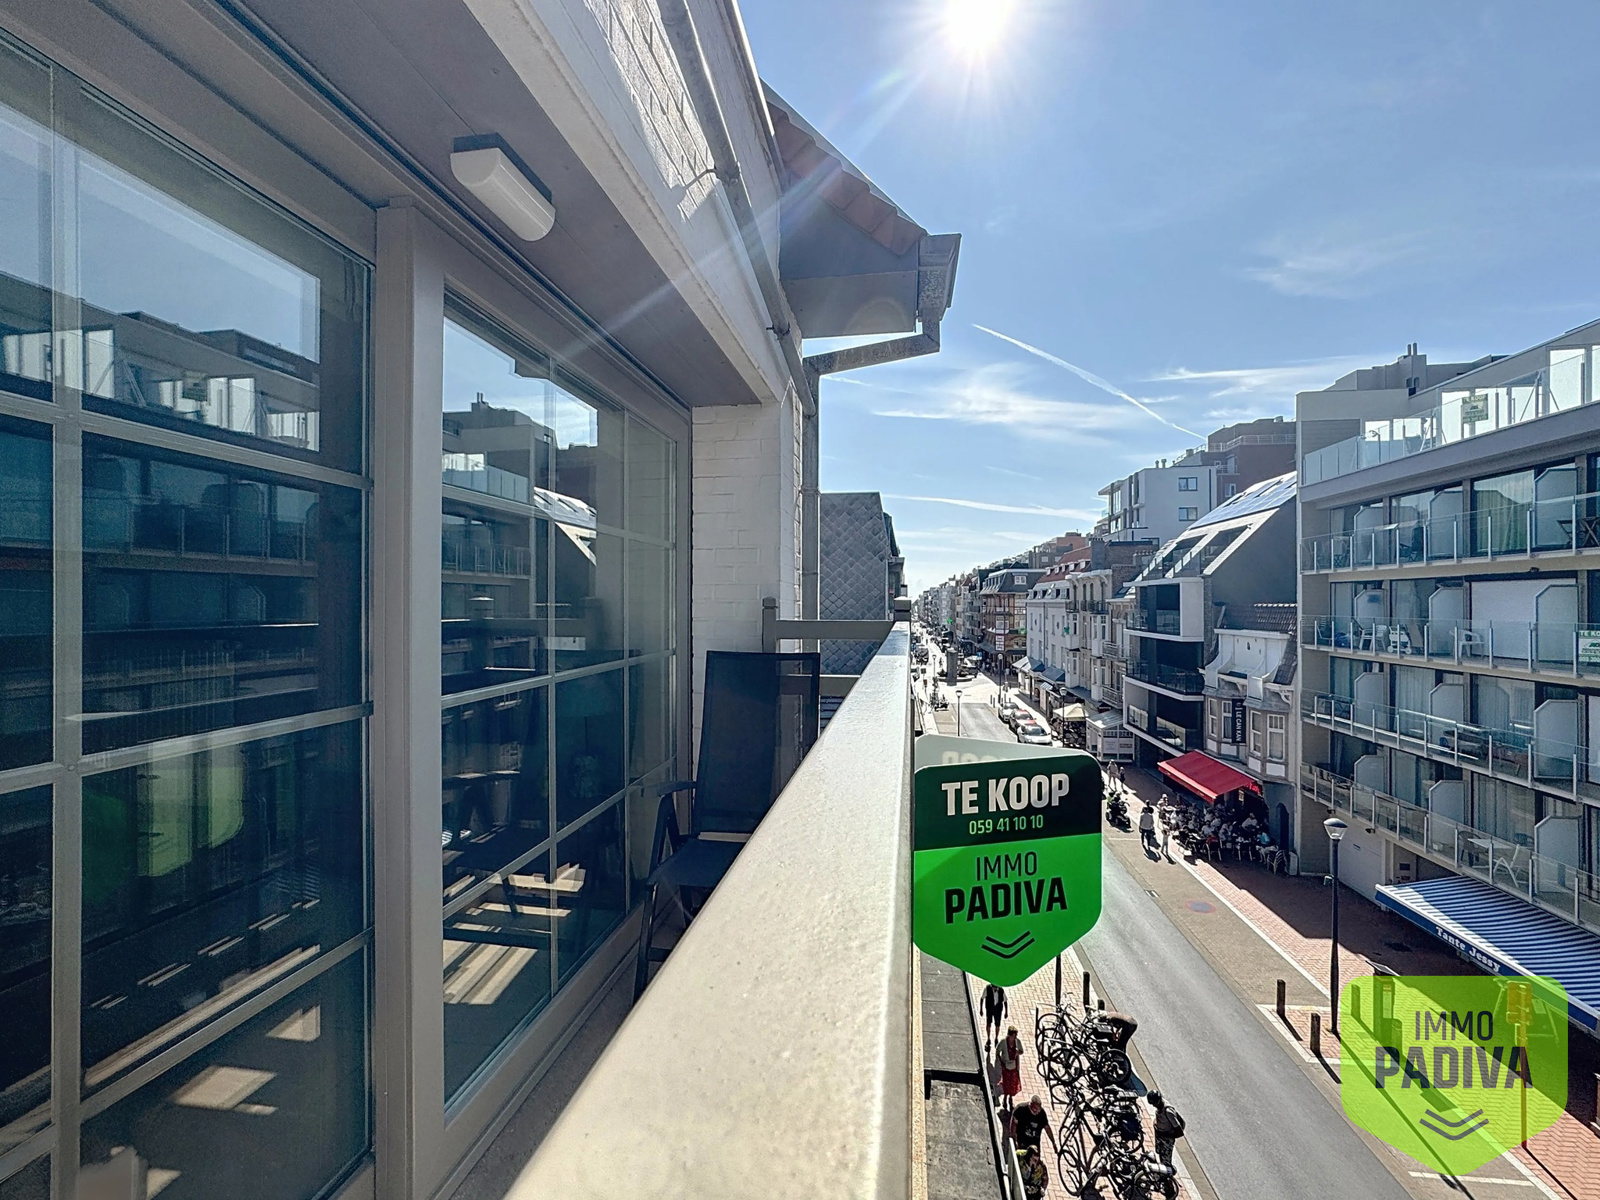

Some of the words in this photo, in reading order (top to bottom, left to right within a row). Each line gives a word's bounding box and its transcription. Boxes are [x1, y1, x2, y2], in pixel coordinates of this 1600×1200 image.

[941, 780, 979, 816] TE
[988, 773, 1070, 812] KOOP
[969, 819, 993, 835] 059
[996, 817, 1010, 832] 41
[1013, 816, 1027, 831] 10
[1030, 814, 1044, 829] 10
[976, 851, 1038, 882] IMMO
[945, 876, 1068, 925] PADIVA
[1435, 926, 1466, 951] Tante
[1469, 947, 1501, 972] Jessy
